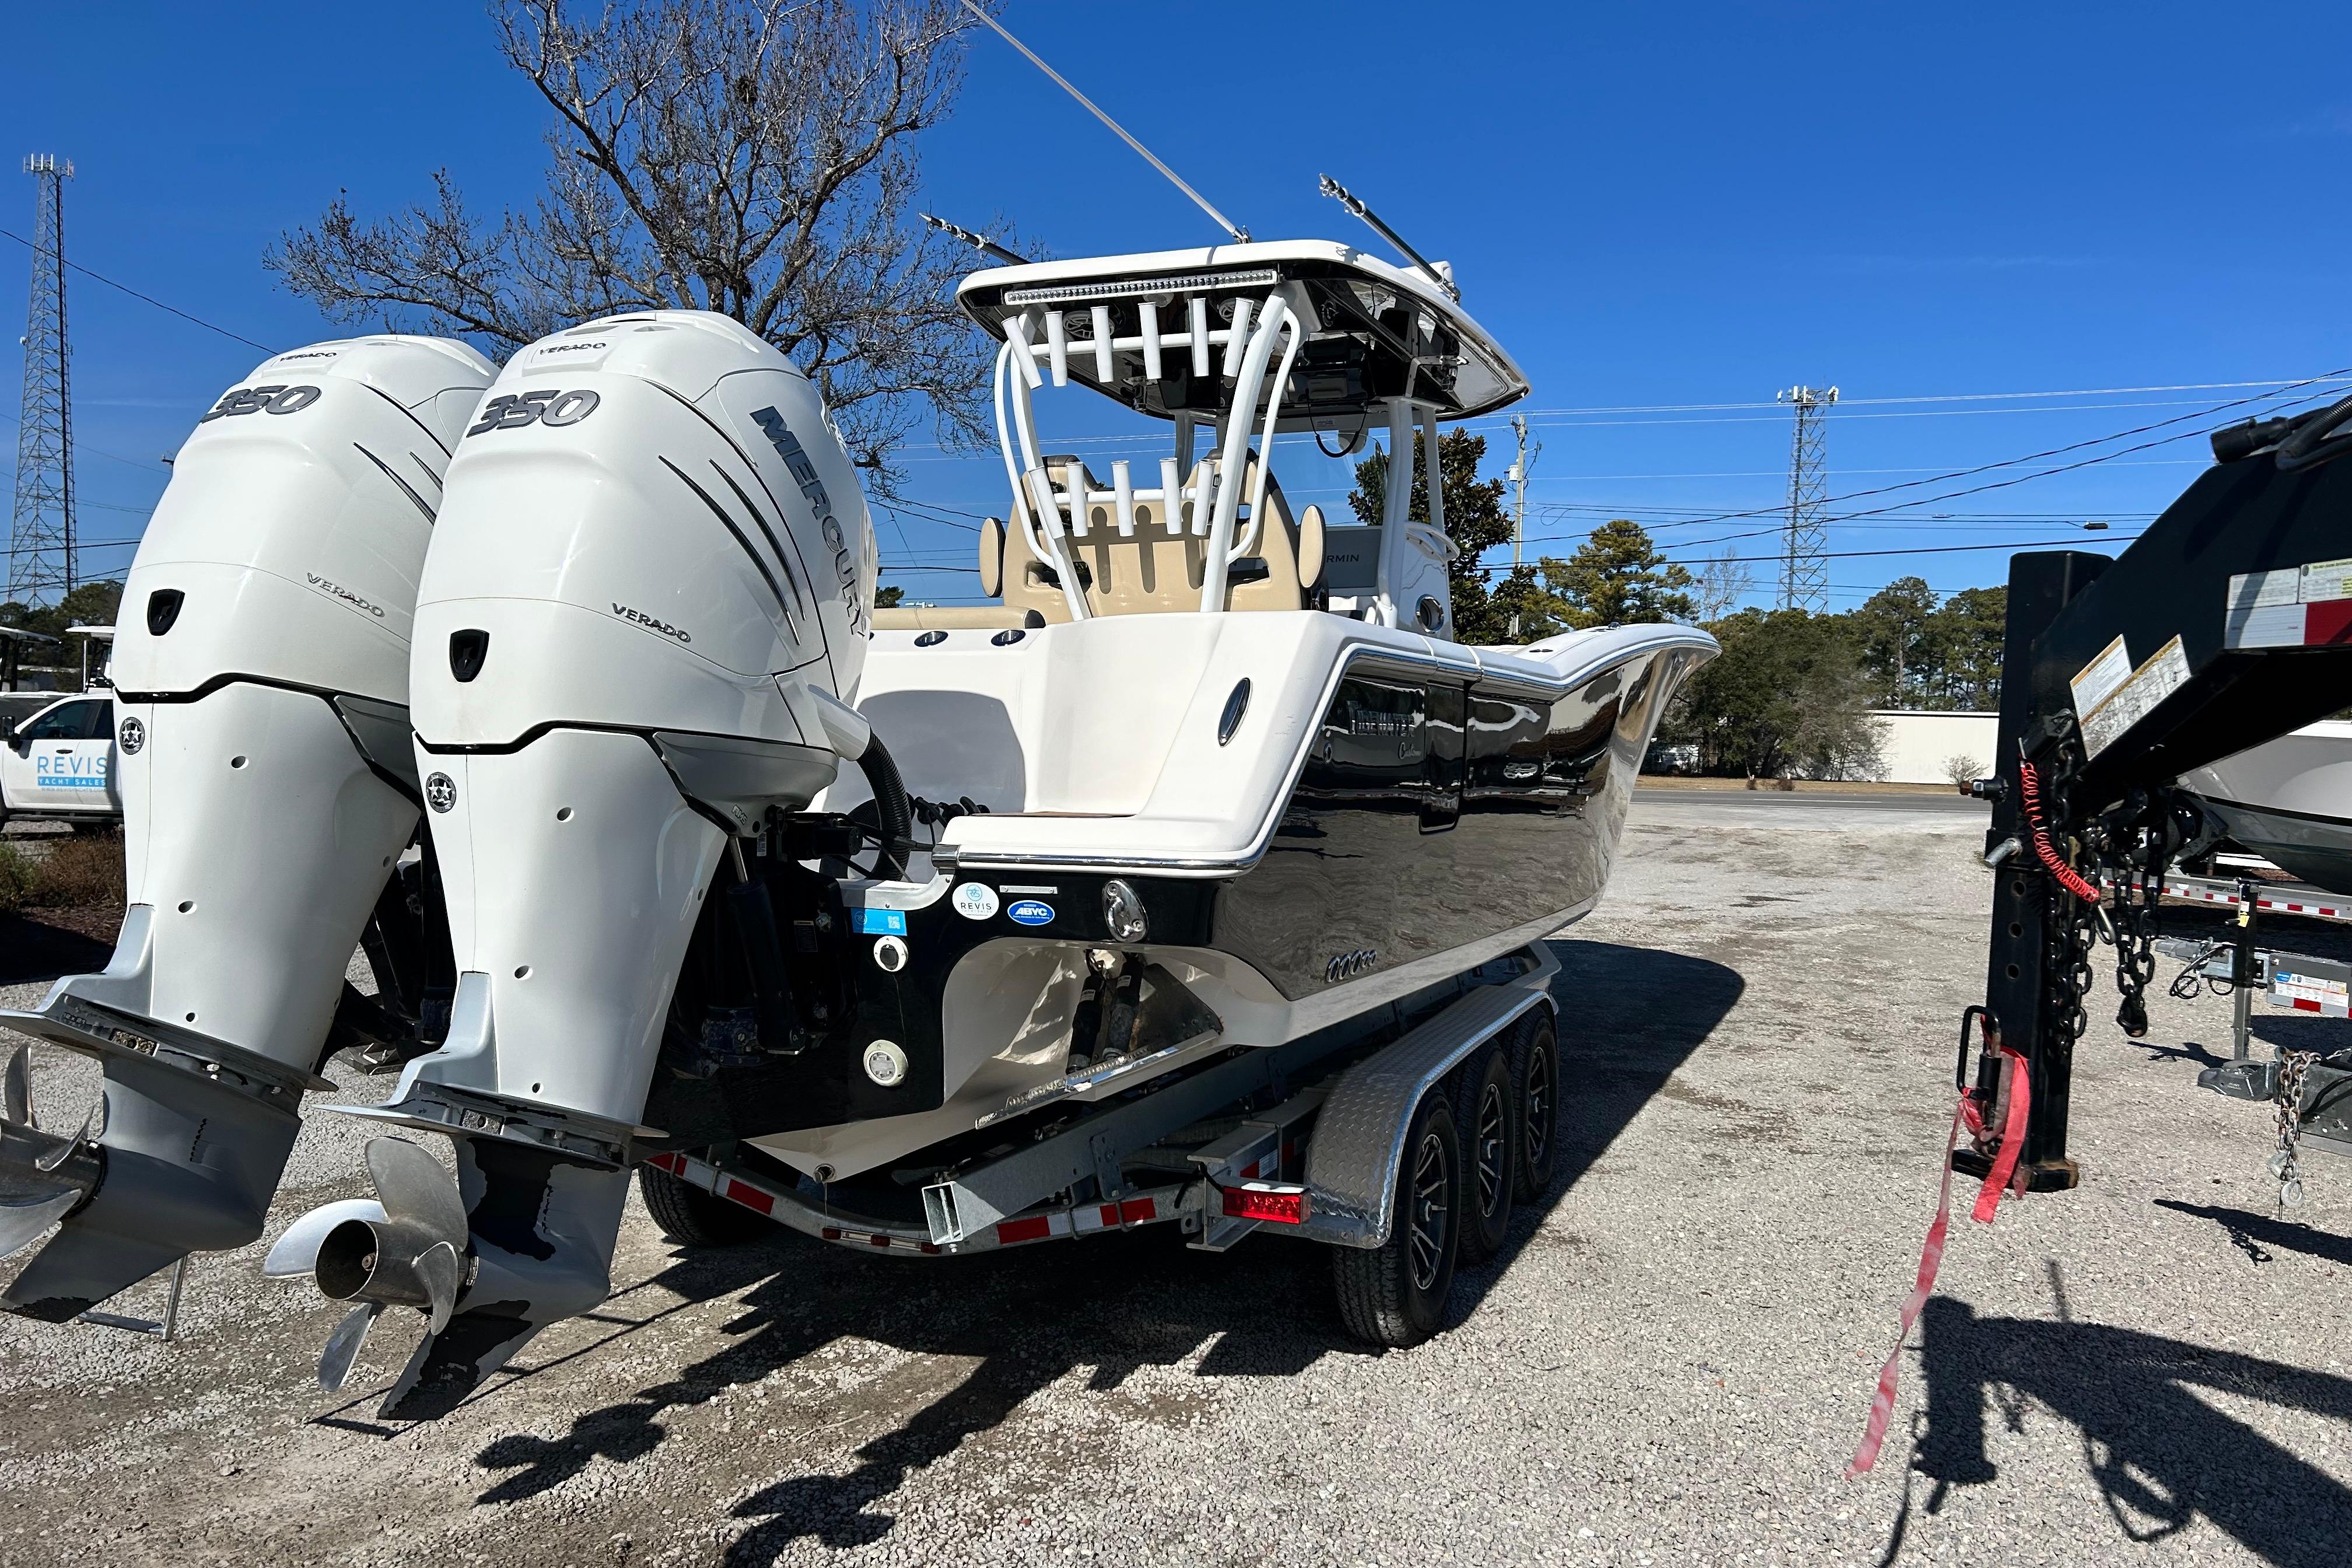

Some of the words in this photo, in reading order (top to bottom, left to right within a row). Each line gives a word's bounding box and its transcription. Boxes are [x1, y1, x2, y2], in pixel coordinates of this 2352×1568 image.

[200, 385, 322, 424] 350
[466, 390, 601, 438] 350
[749, 405, 866, 638] MERCURY
[1326, 554, 1360, 563] RMIN
[307, 572, 385, 618] VERADO
[612, 602, 691, 643] VERADO
[37, 755, 107, 775] REVIS
[961, 902, 992, 910] REVIS
[1014, 907, 1048, 916] ABYC
